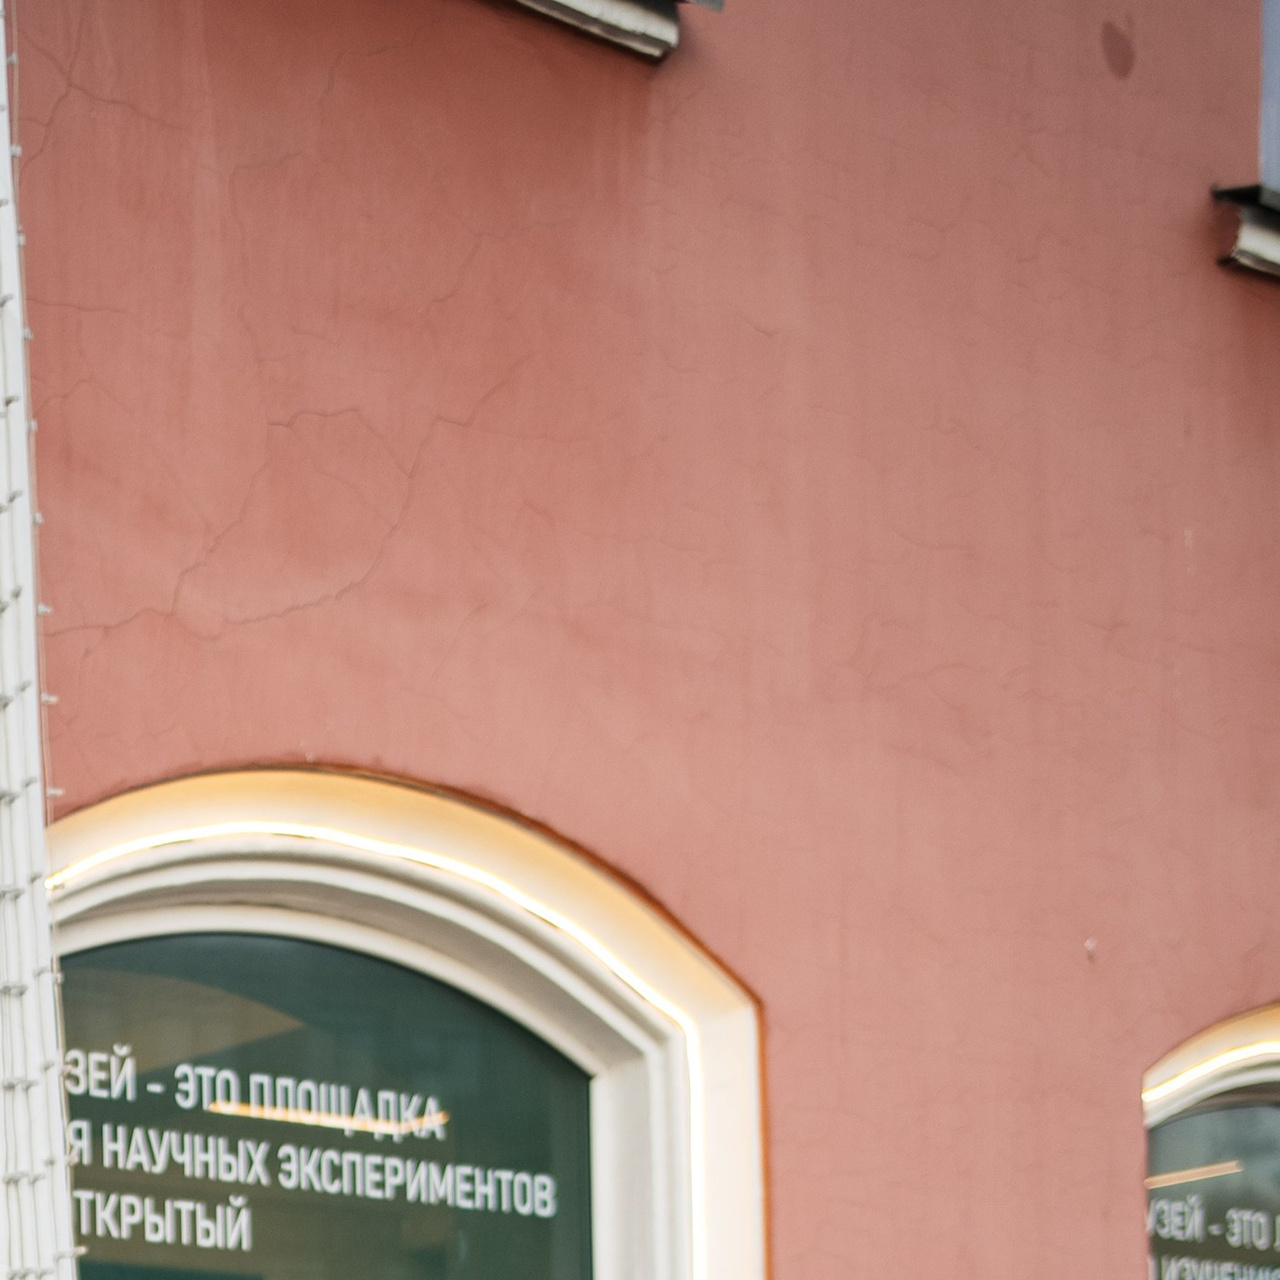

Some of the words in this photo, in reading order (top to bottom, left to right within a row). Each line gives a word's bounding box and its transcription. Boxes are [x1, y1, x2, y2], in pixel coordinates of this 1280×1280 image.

[174, 1063, 241, 1114] ЭТО
[249, 1073, 447, 1142] ПЛОЩАДКА
[102, 1122, 270, 1187] НАУЧНЫХ
[277, 1144, 556, 1218] ЭКСПЕРИМЕНТОВ
[73, 1189, 252, 1251] ТКРЫТЫЙ
[1225, 1207, 1270, 1250] ЭТО
